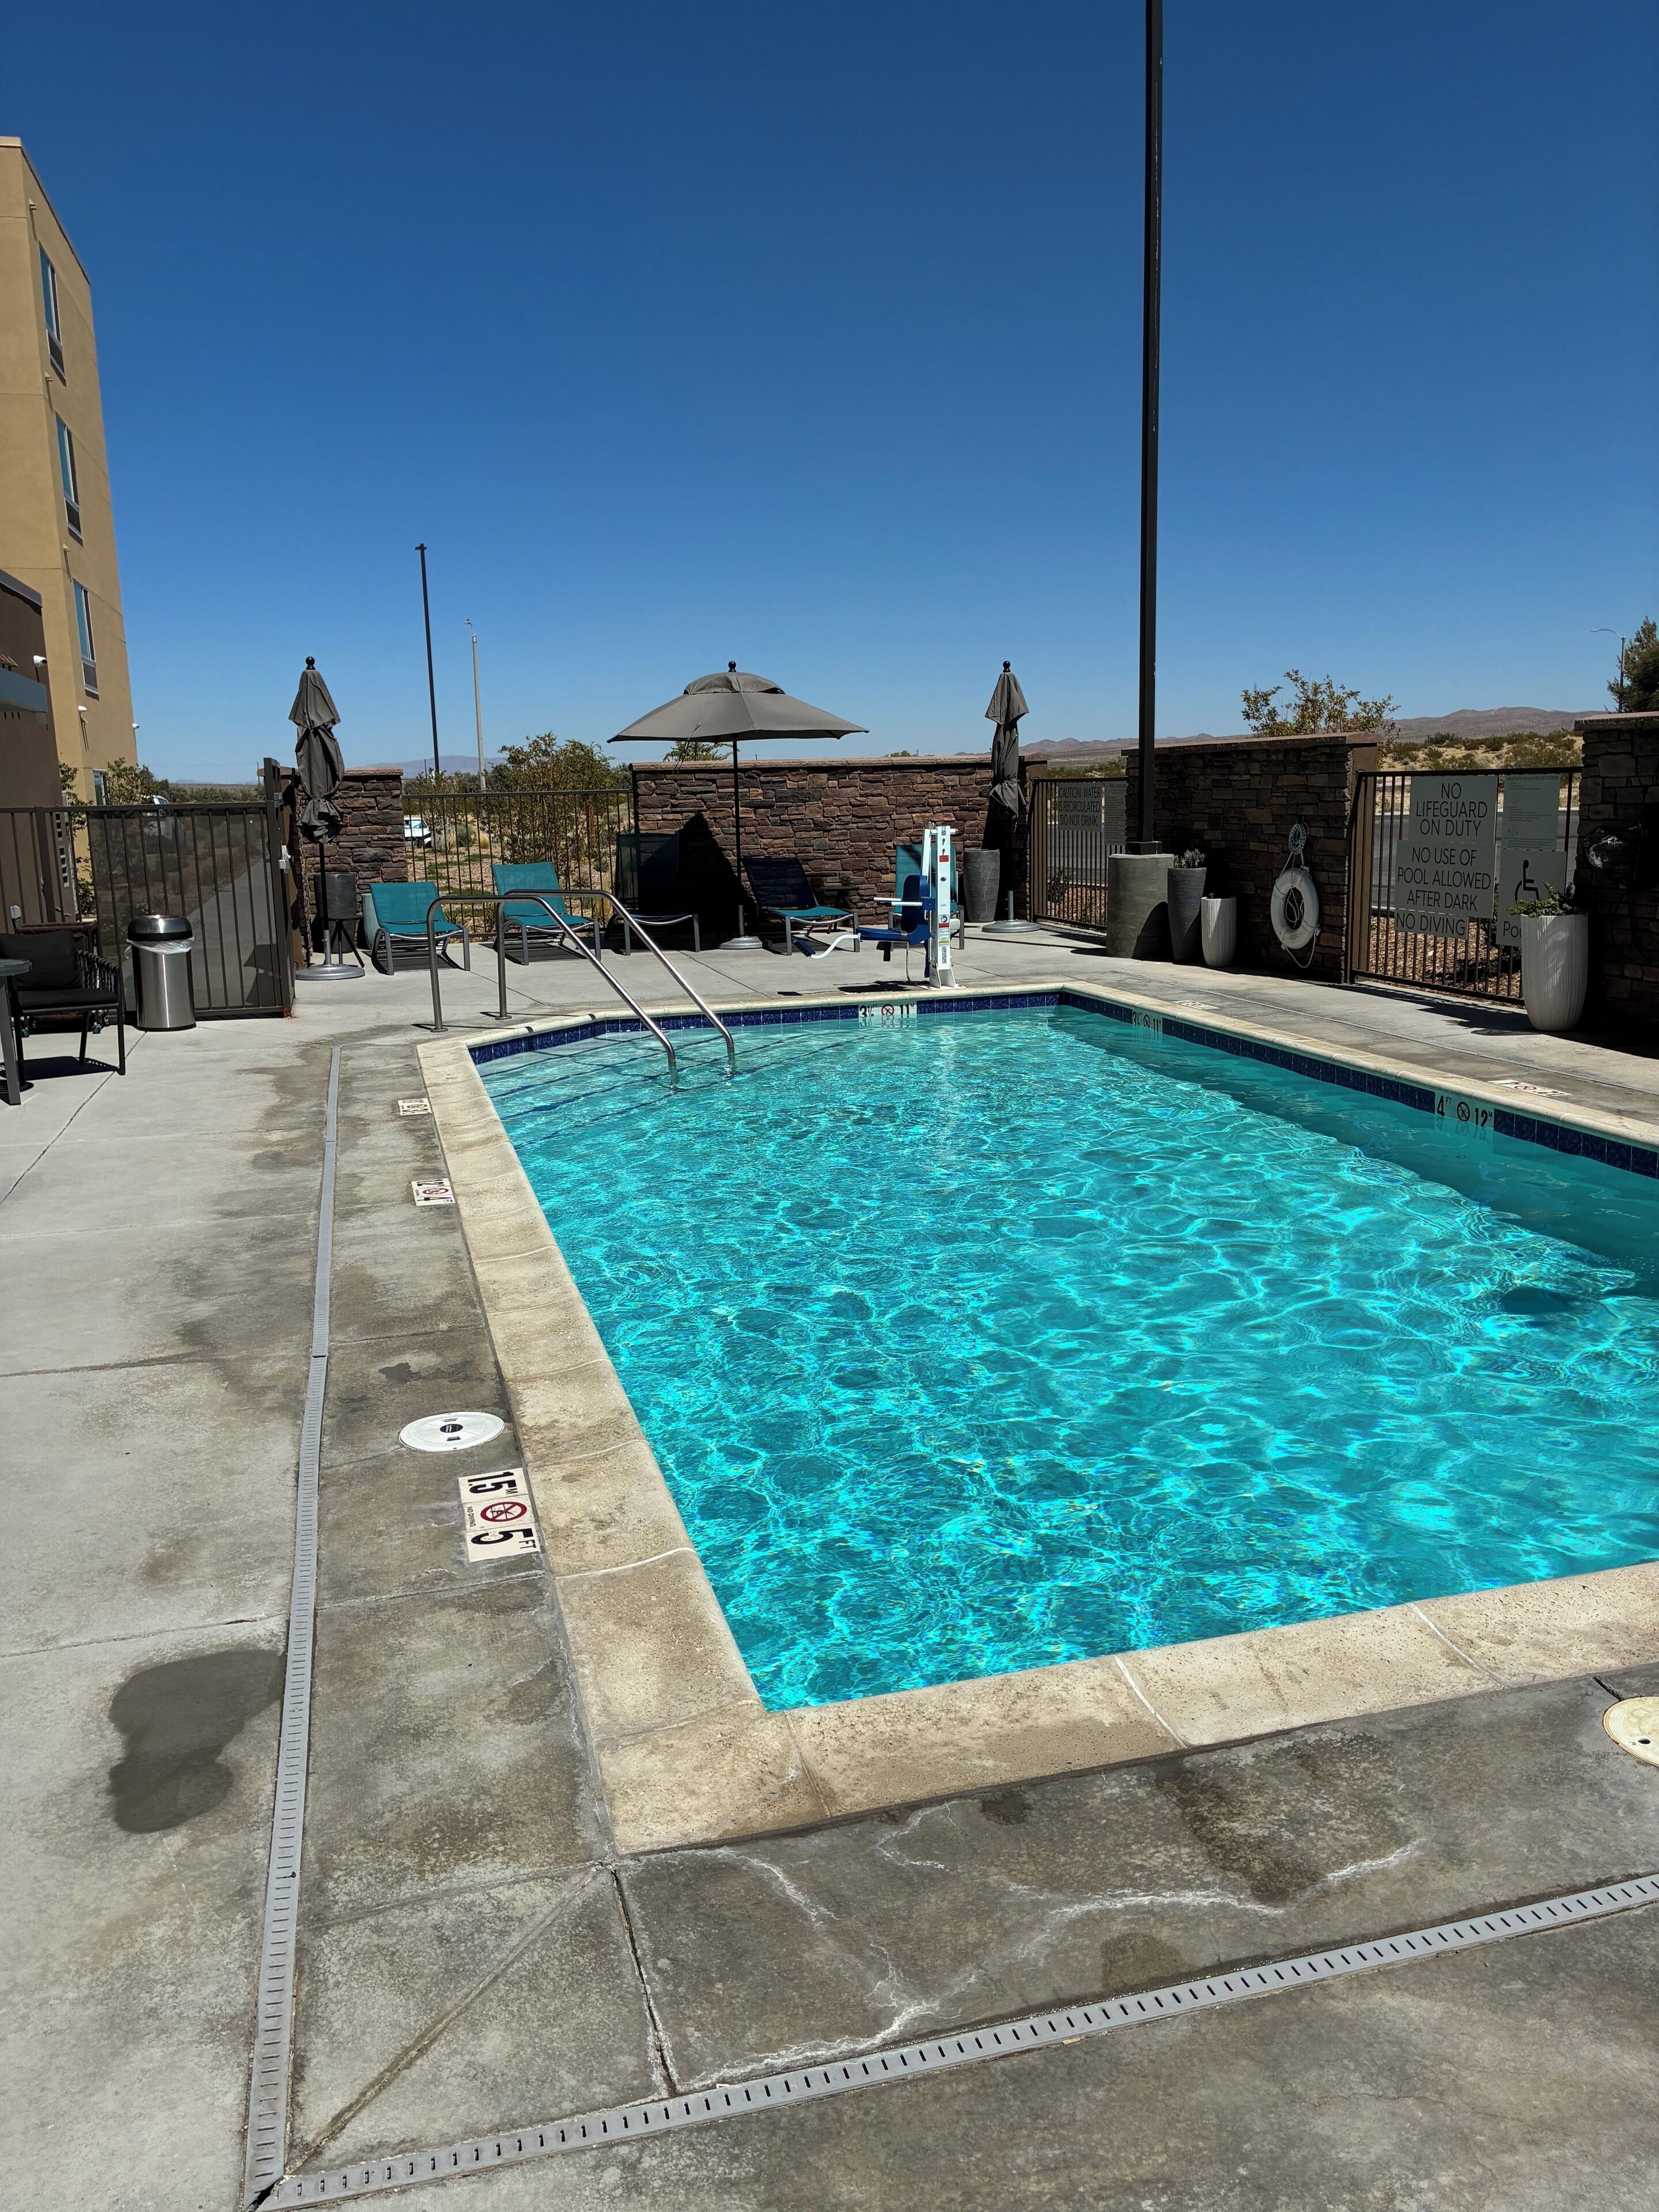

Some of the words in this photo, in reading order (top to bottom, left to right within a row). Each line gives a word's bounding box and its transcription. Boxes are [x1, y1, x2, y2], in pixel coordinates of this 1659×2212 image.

[1084, 787, 1101, 798] WATER
[1441, 782, 1461, 800] NO
[1416, 801, 1488, 818] LIFEGUARD
[1060, 815, 1069, 825] DO
[1070, 815, 1080, 826] NOT
[1420, 819, 1440, 836] ON
[1445, 819, 1482, 837] DUTY
[1412, 846, 1431, 863] NO
[1434, 847, 1456, 865] USE
[1460, 849, 1478, 866] OF
[1397, 867, 1429, 884] POOL
[1432, 870, 1491, 890] ALLOWED
[1407, 889, 1441, 908] AFTER
[1444, 892, 1478, 912] DARK
[1396, 912, 1415, 929] NO
[1420, 915, 1466, 936] DIVING
[1503, 921, 1522, 938] Po
[1437, 1095, 1445, 1117] 4
[1446, 1096, 1452, 1105] FT
[467, 1471, 517, 1494] 1.5
[471, 1528, 534, 1545] 5
[518, 1539, 537, 1549] FT
